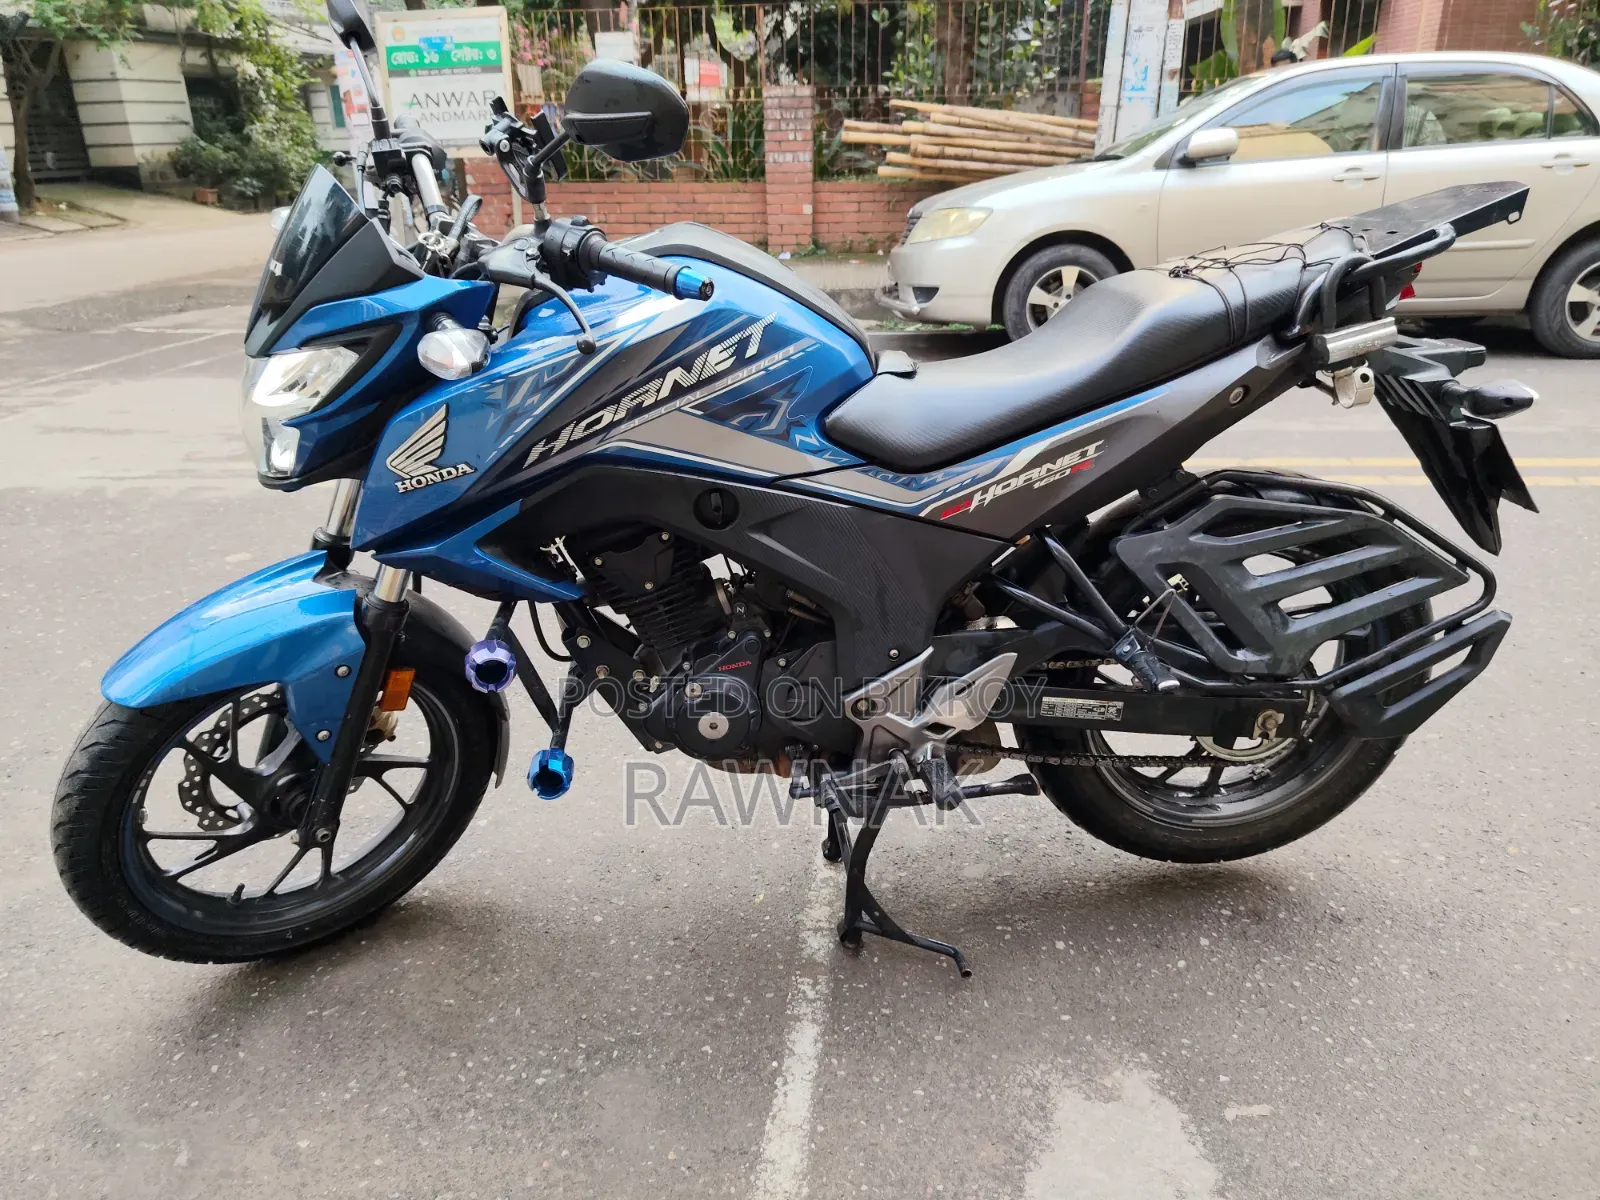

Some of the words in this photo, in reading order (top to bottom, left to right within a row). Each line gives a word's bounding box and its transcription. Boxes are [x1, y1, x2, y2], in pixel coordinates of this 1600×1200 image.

[409, 110, 494, 123] ANDMAR
[523, 312, 777, 469] HORNET
[619, 389, 708, 431] SPECIAL
[713, 345, 796, 389] EDITION
[395, 463, 475, 493] HONDA
[969, 439, 1105, 513] HORNET
[718, 660, 752, 672] HONDA
